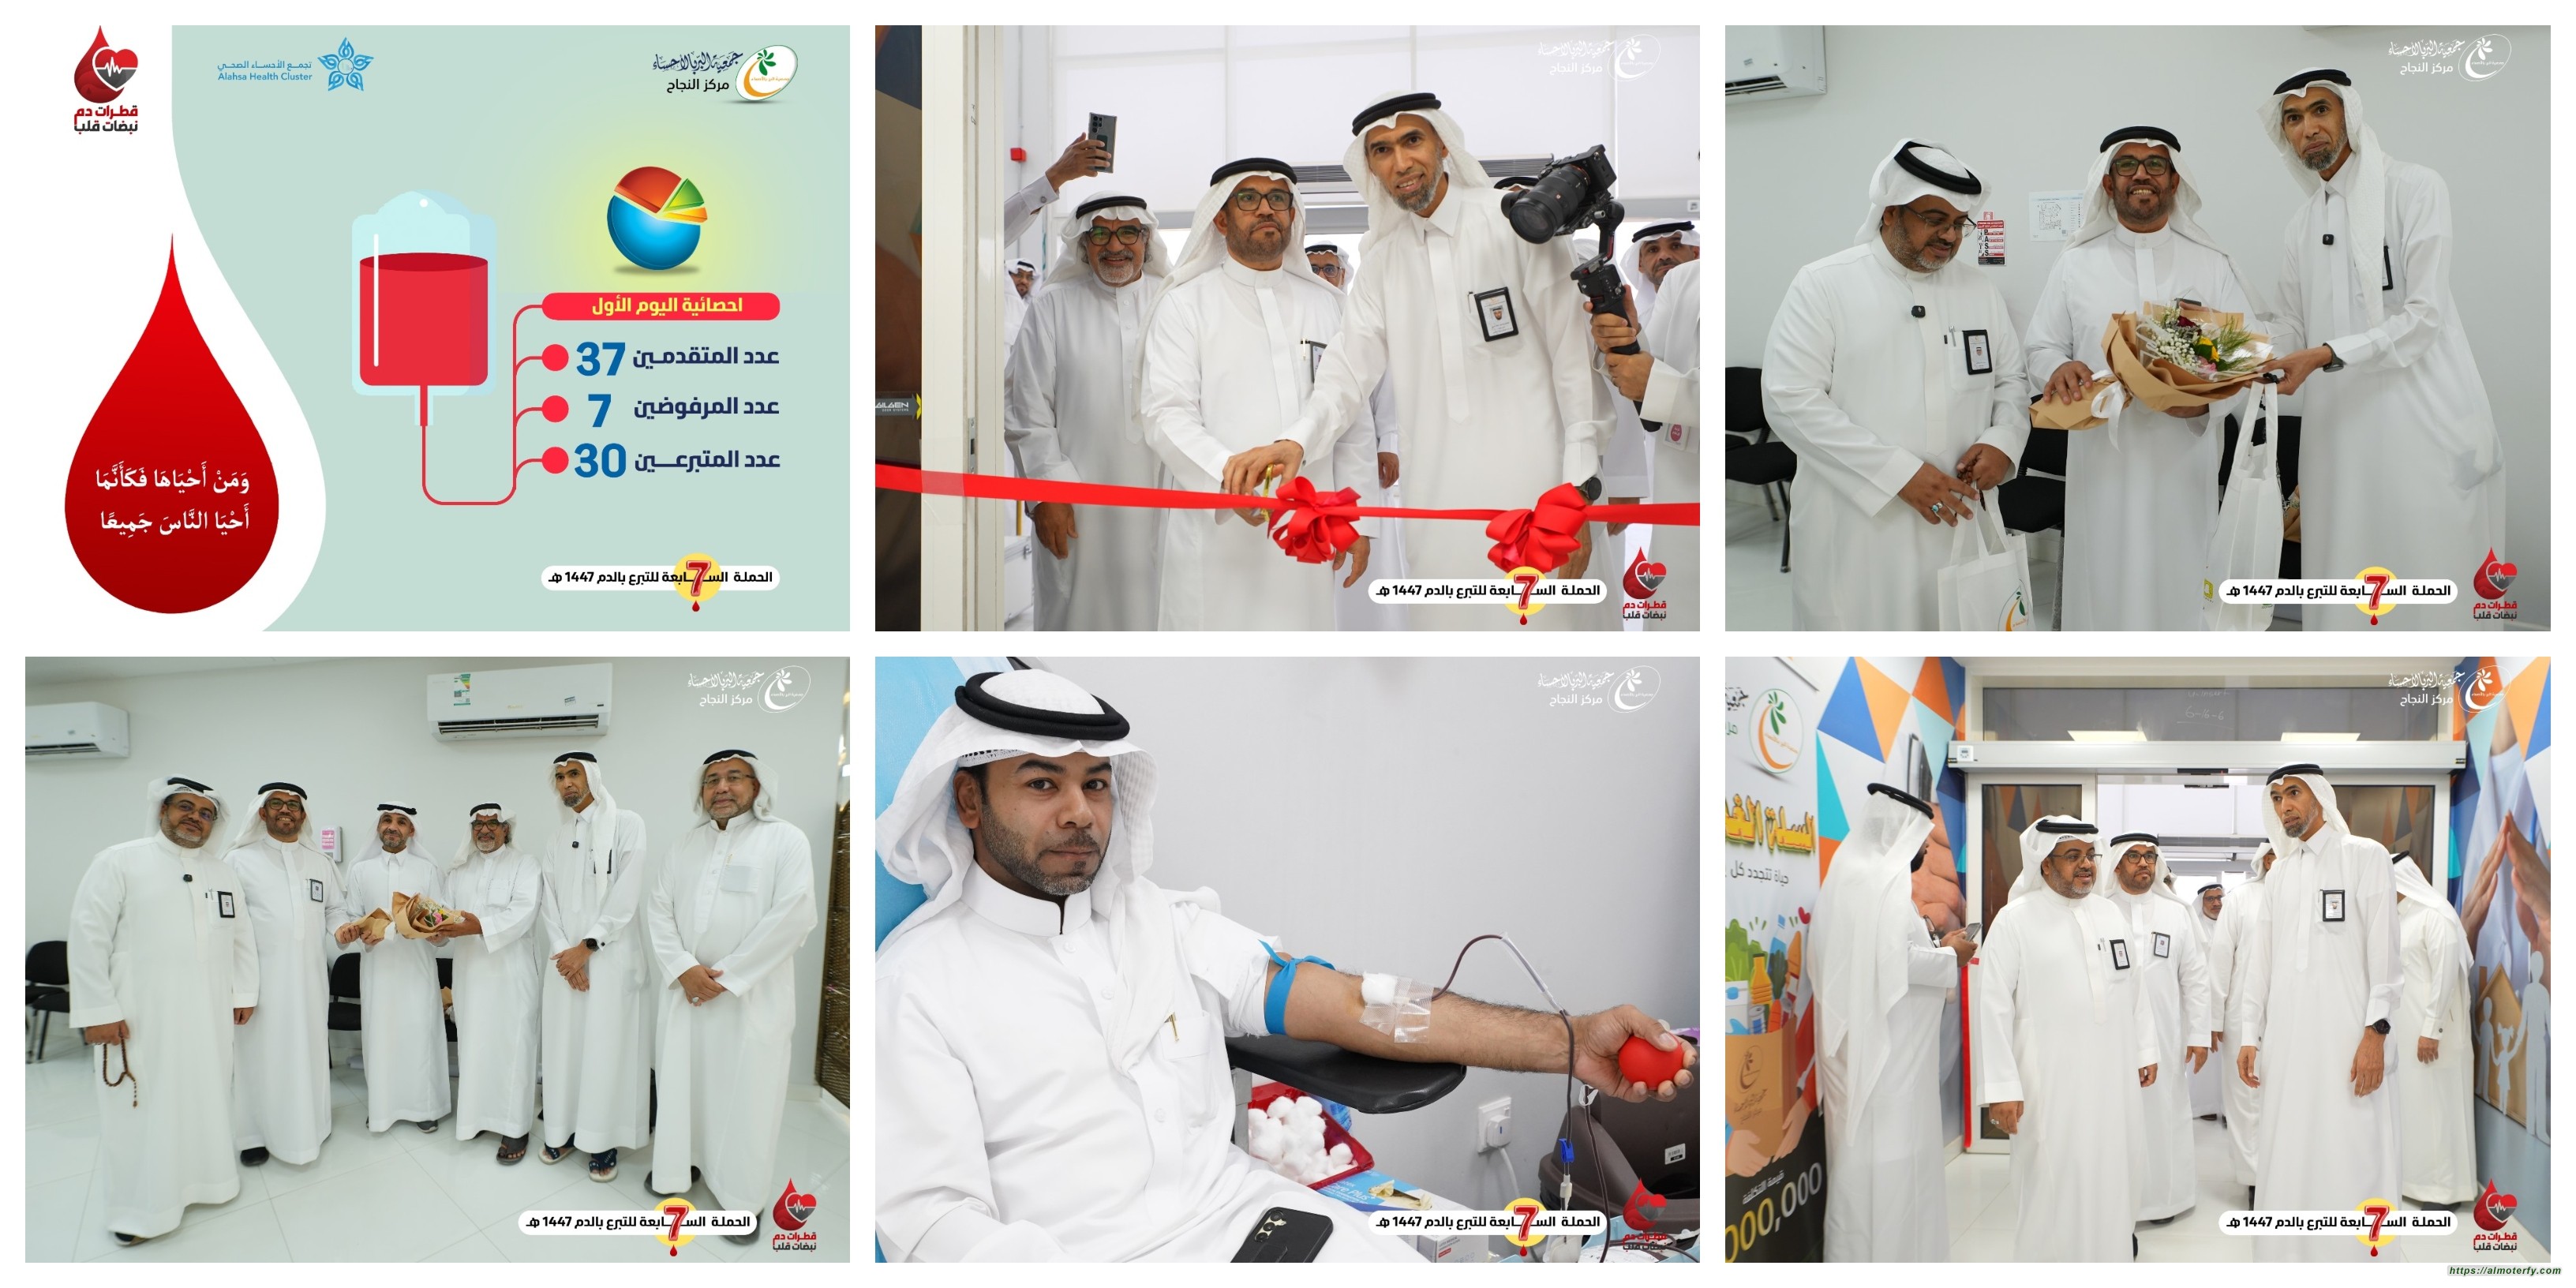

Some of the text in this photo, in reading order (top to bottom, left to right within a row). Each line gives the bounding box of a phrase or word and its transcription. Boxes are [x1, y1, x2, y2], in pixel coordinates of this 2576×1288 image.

[217, 72, 313, 80] Alahsa Health Cluster
[666, 78, 730, 94] مركز النجاح
[73, 104, 138, 125] قطرات دم
[73, 118, 138, 135] نبضات قلب
[591, 295, 743, 316] احصائية اليوم الأول
[576, 341, 626, 376] 37
[743, 351, 780, 365] عدد
[587, 393, 780, 428] عدد المرفوضين 7
[574, 442, 627, 478] 30
[743, 455, 781, 468] عدد
[564, 571, 594, 582] 1447
[597, 571, 626, 586] بالدم
[628, 571, 659, 586] للتبرع
[733, 571, 773, 582] الحملة
[1730, 859, 1745, 878] كل
[1774, 870, 1790, 887] حياة
